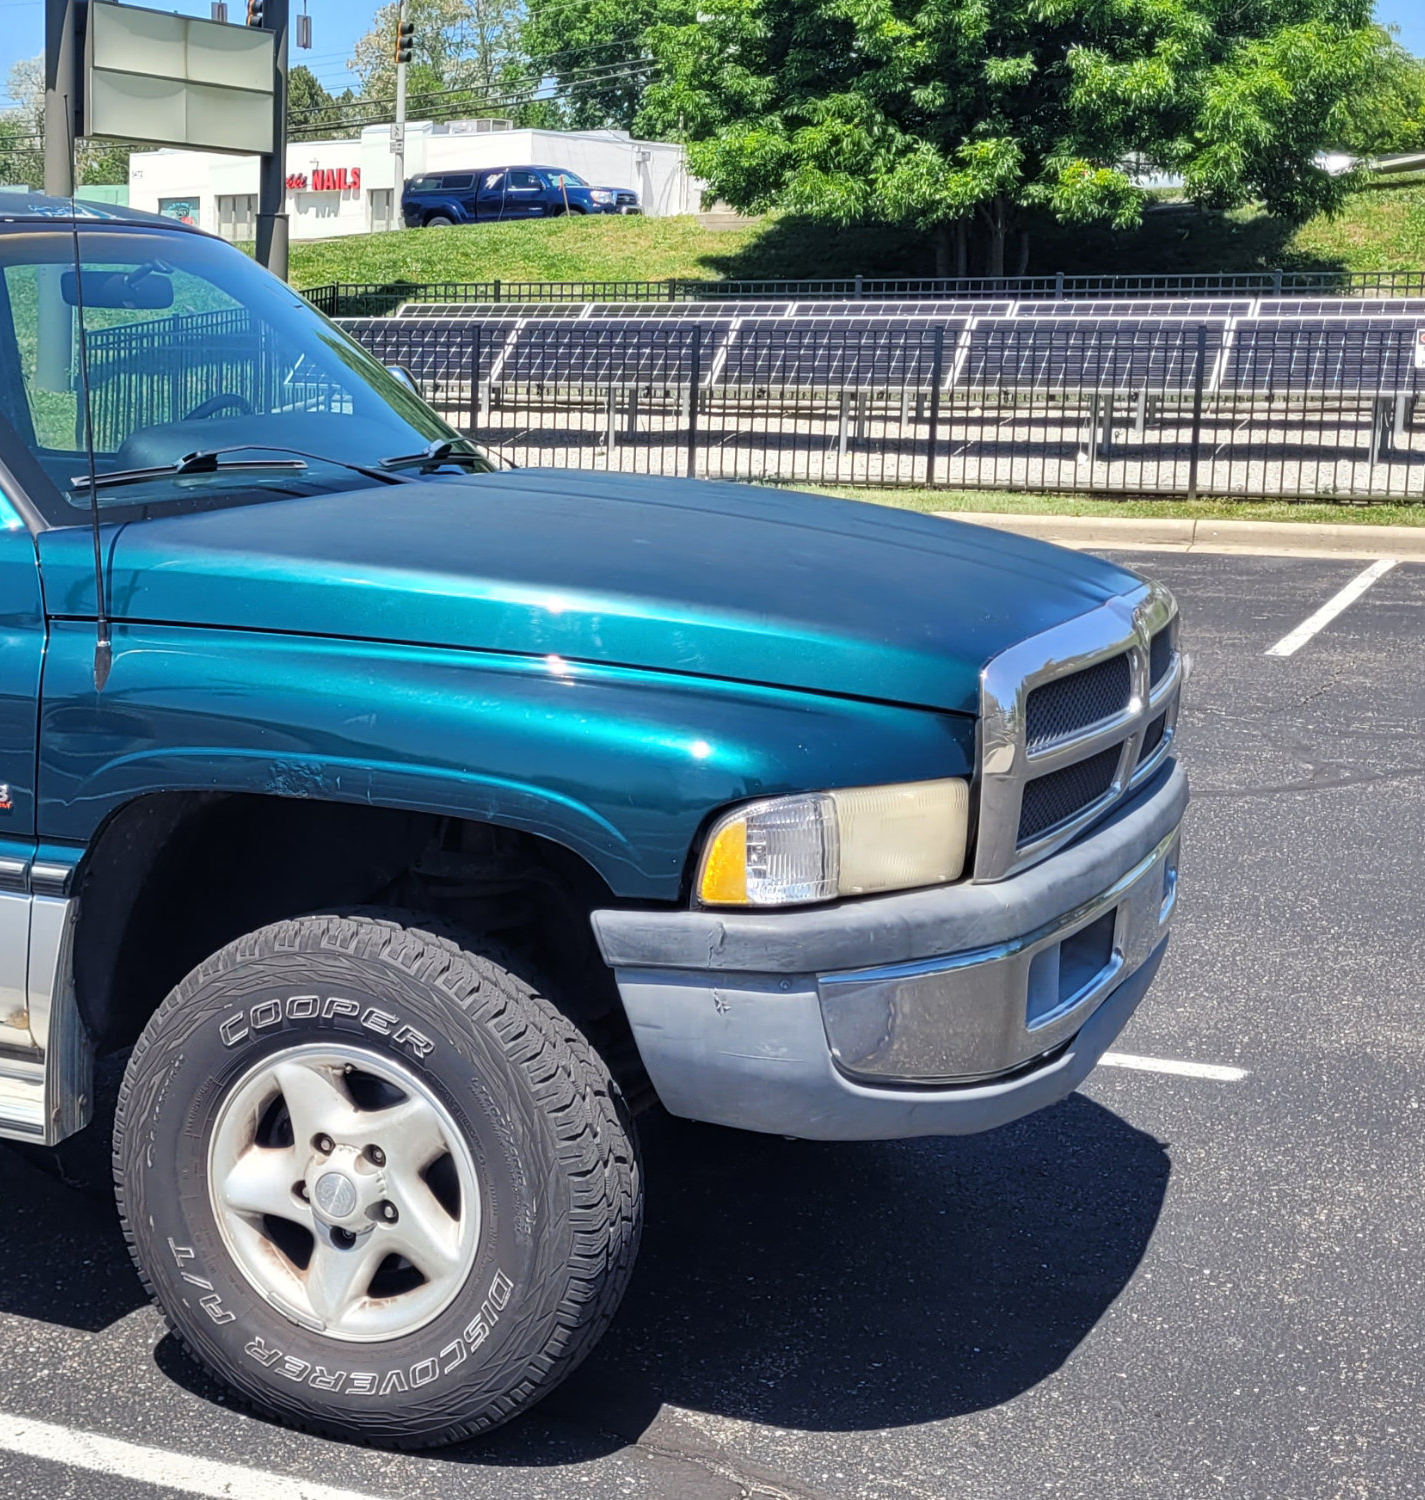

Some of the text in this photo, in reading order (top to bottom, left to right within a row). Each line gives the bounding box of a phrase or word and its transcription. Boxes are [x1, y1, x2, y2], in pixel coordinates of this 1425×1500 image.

[312, 167, 361, 190] NAILS
[218, 994, 437, 1061] COOPER
[166, 1236, 515, 1397] DISCOVERER A/T
